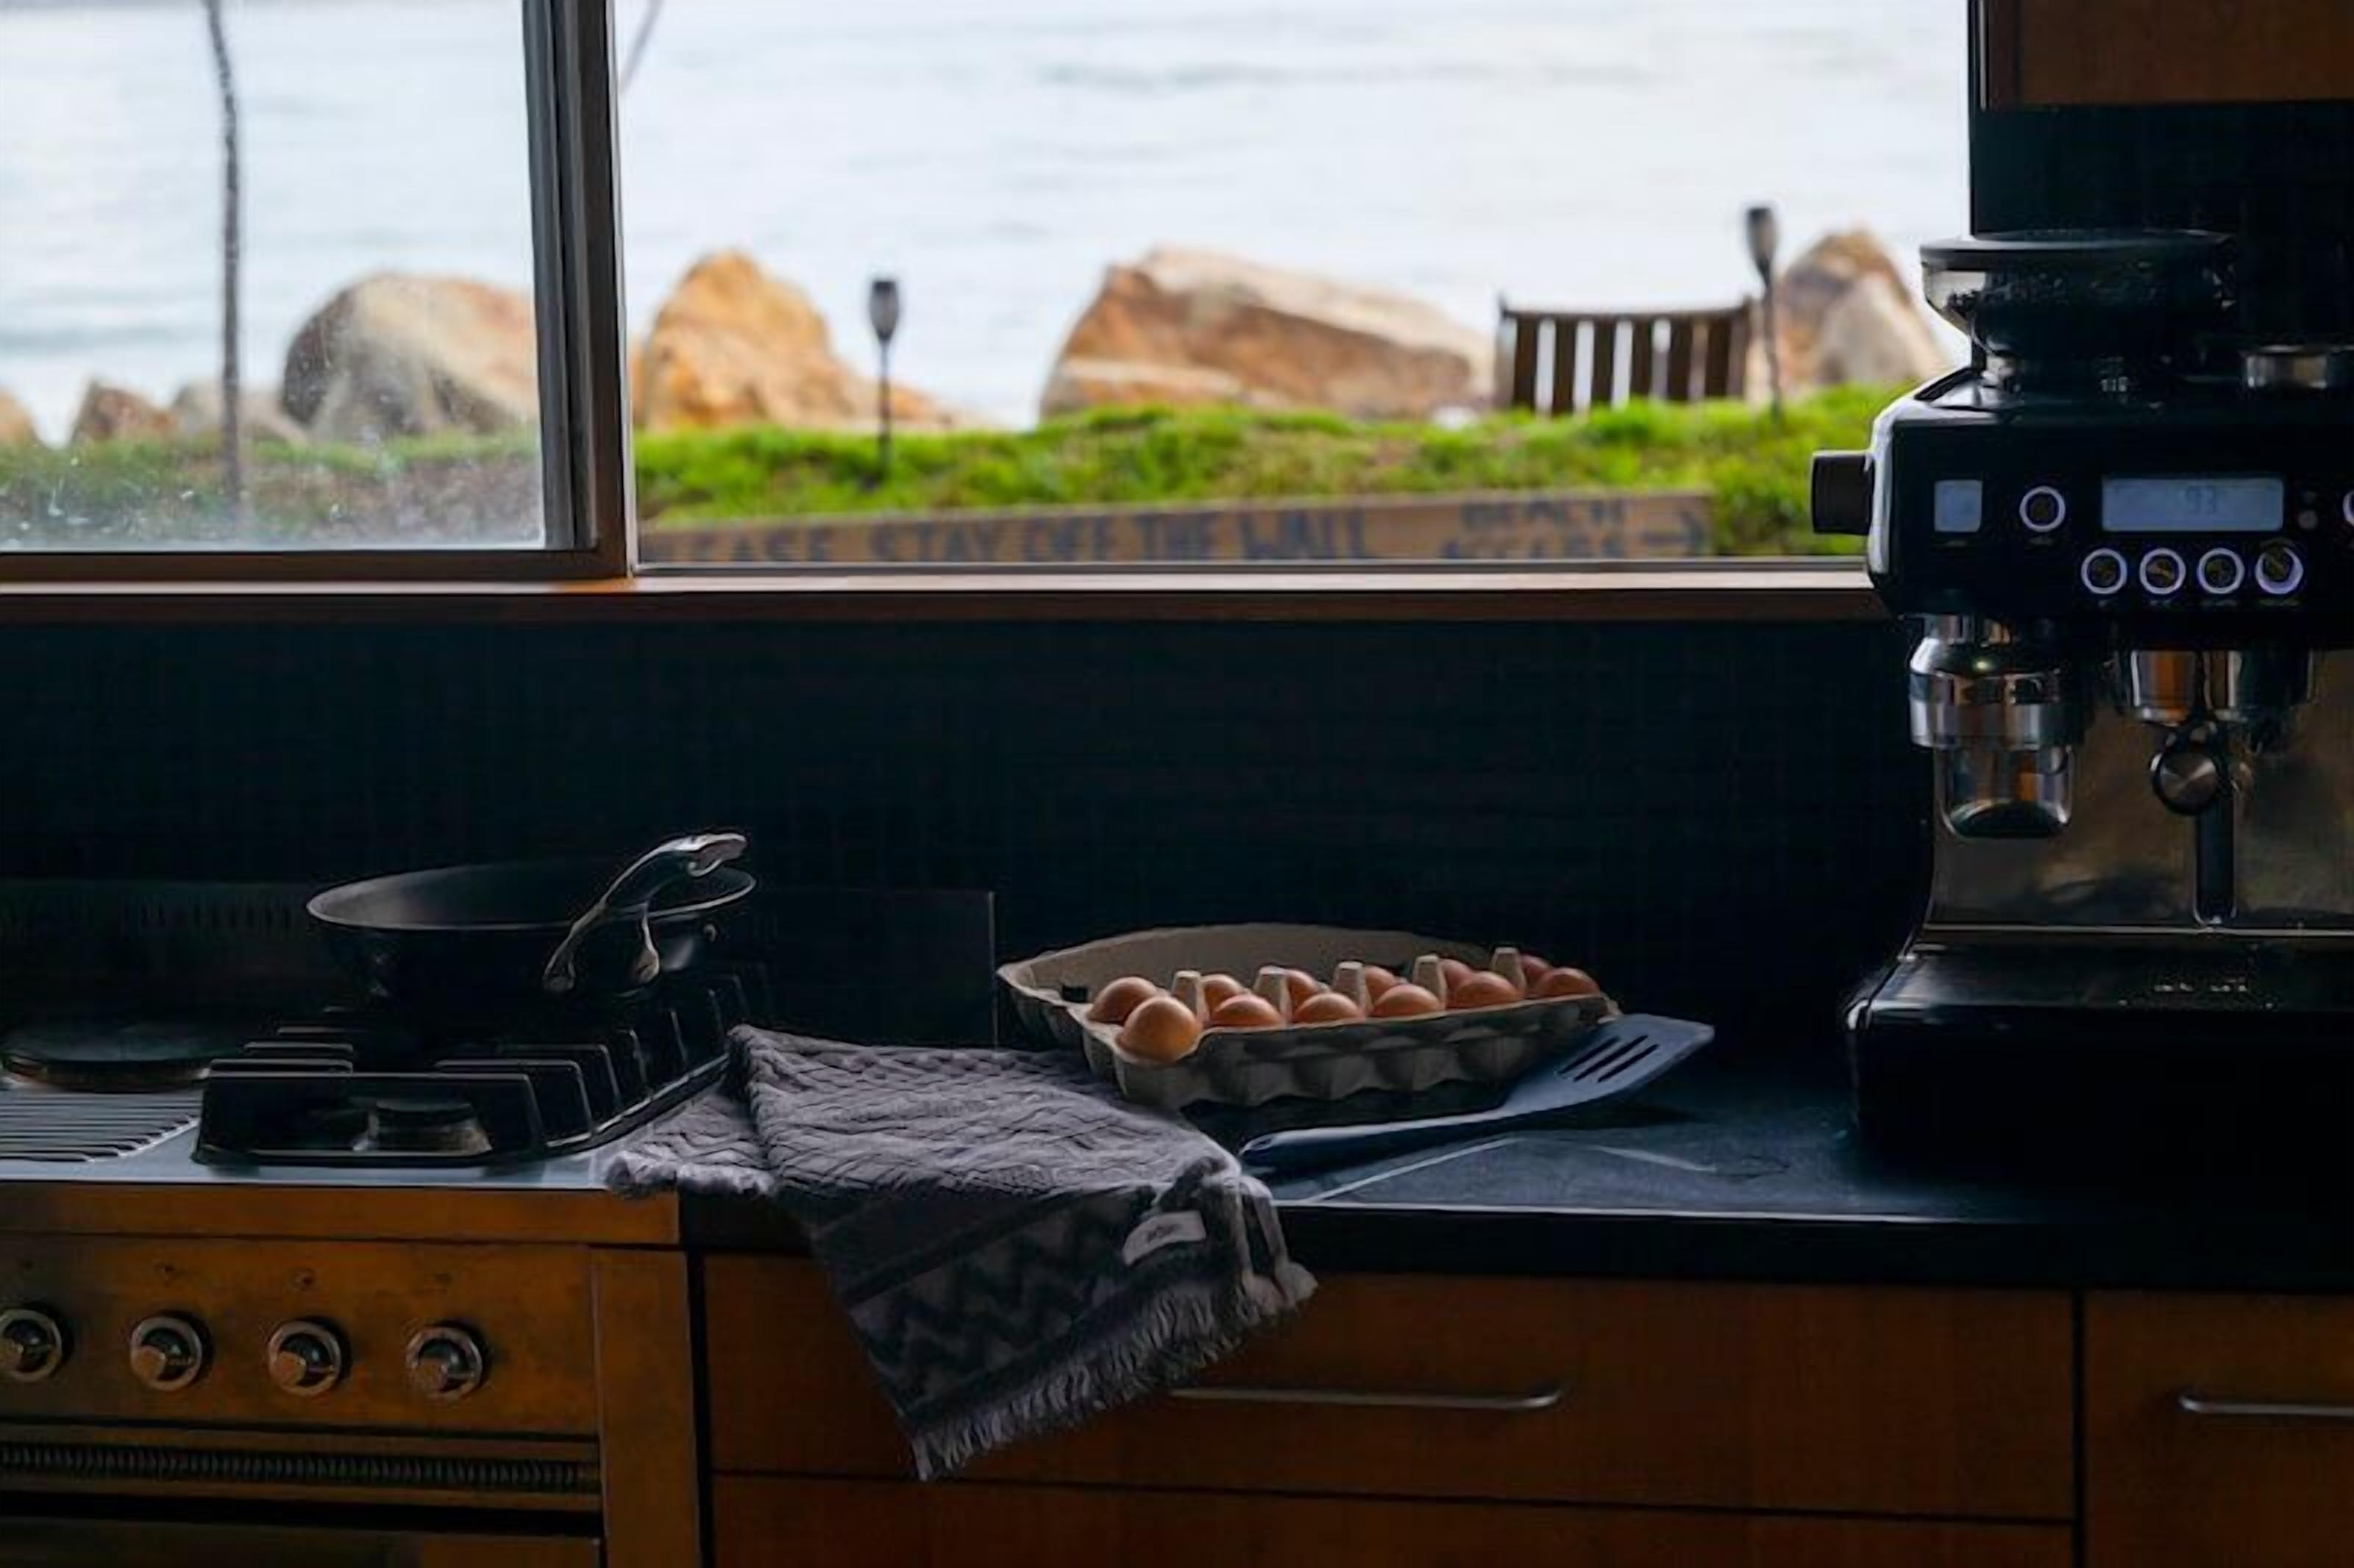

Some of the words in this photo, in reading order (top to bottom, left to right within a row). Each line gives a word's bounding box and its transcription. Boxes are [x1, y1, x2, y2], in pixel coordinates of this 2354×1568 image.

[869, 520, 1008, 562] STAY
[1022, 516, 1117, 562] OFF
[1131, 513, 1221, 560] THE
[1237, 509, 1373, 560] WALL
